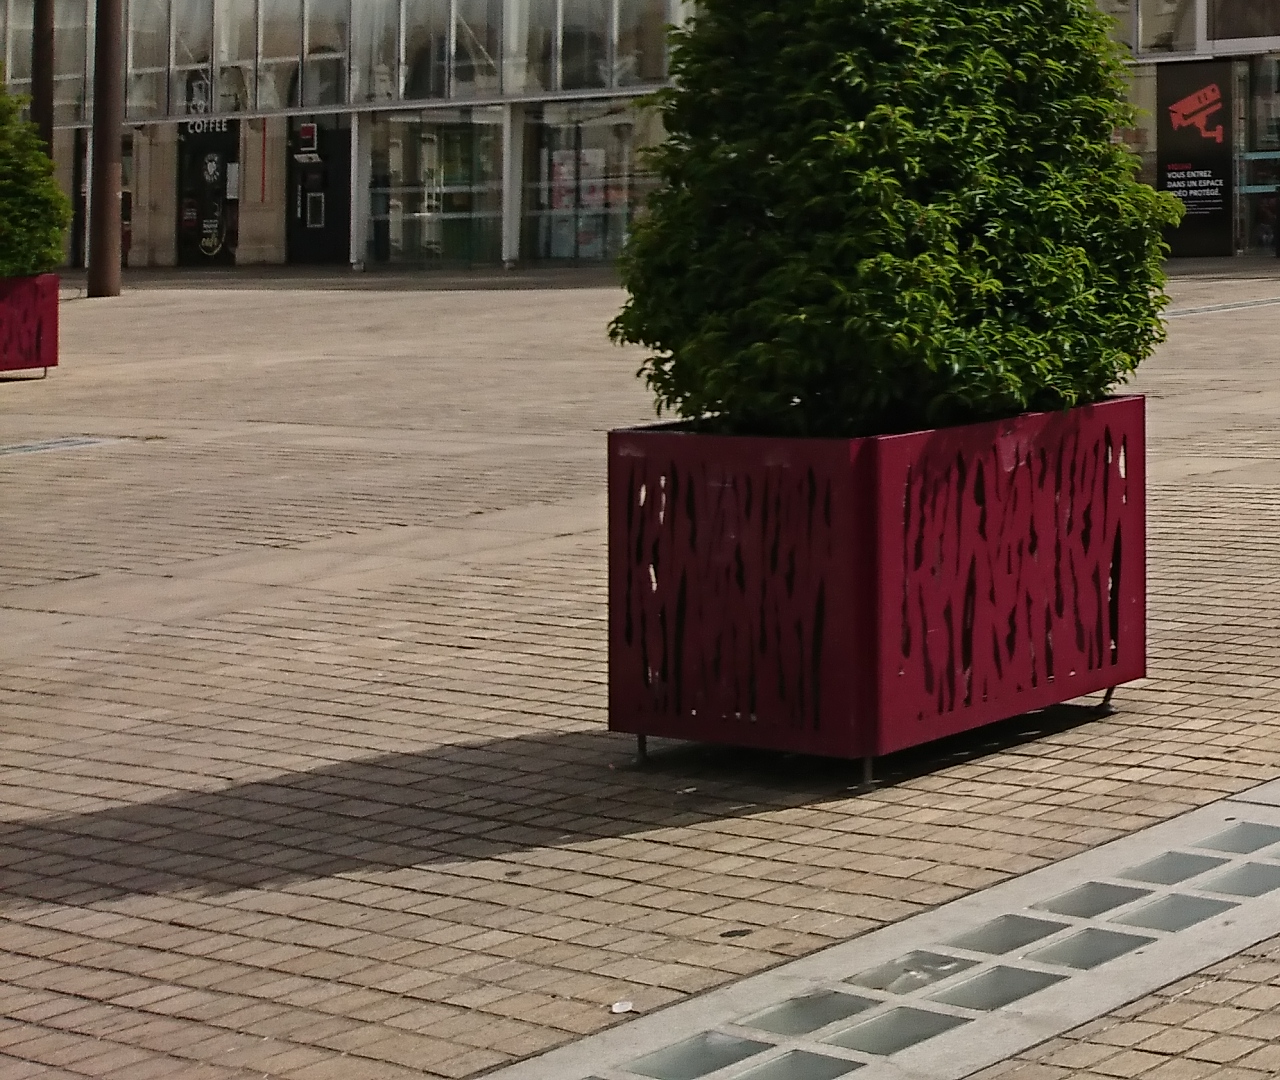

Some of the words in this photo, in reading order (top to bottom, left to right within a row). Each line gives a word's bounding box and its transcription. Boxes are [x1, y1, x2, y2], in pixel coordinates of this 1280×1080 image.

[187, 120, 228, 134] COFFEE
[1167, 171, 1186, 179] VOUS
[1186, 170, 1212, 178] ENTREZ
[1167, 180, 1186, 188] DANS
[1198, 179, 1224, 187] ESPACE
